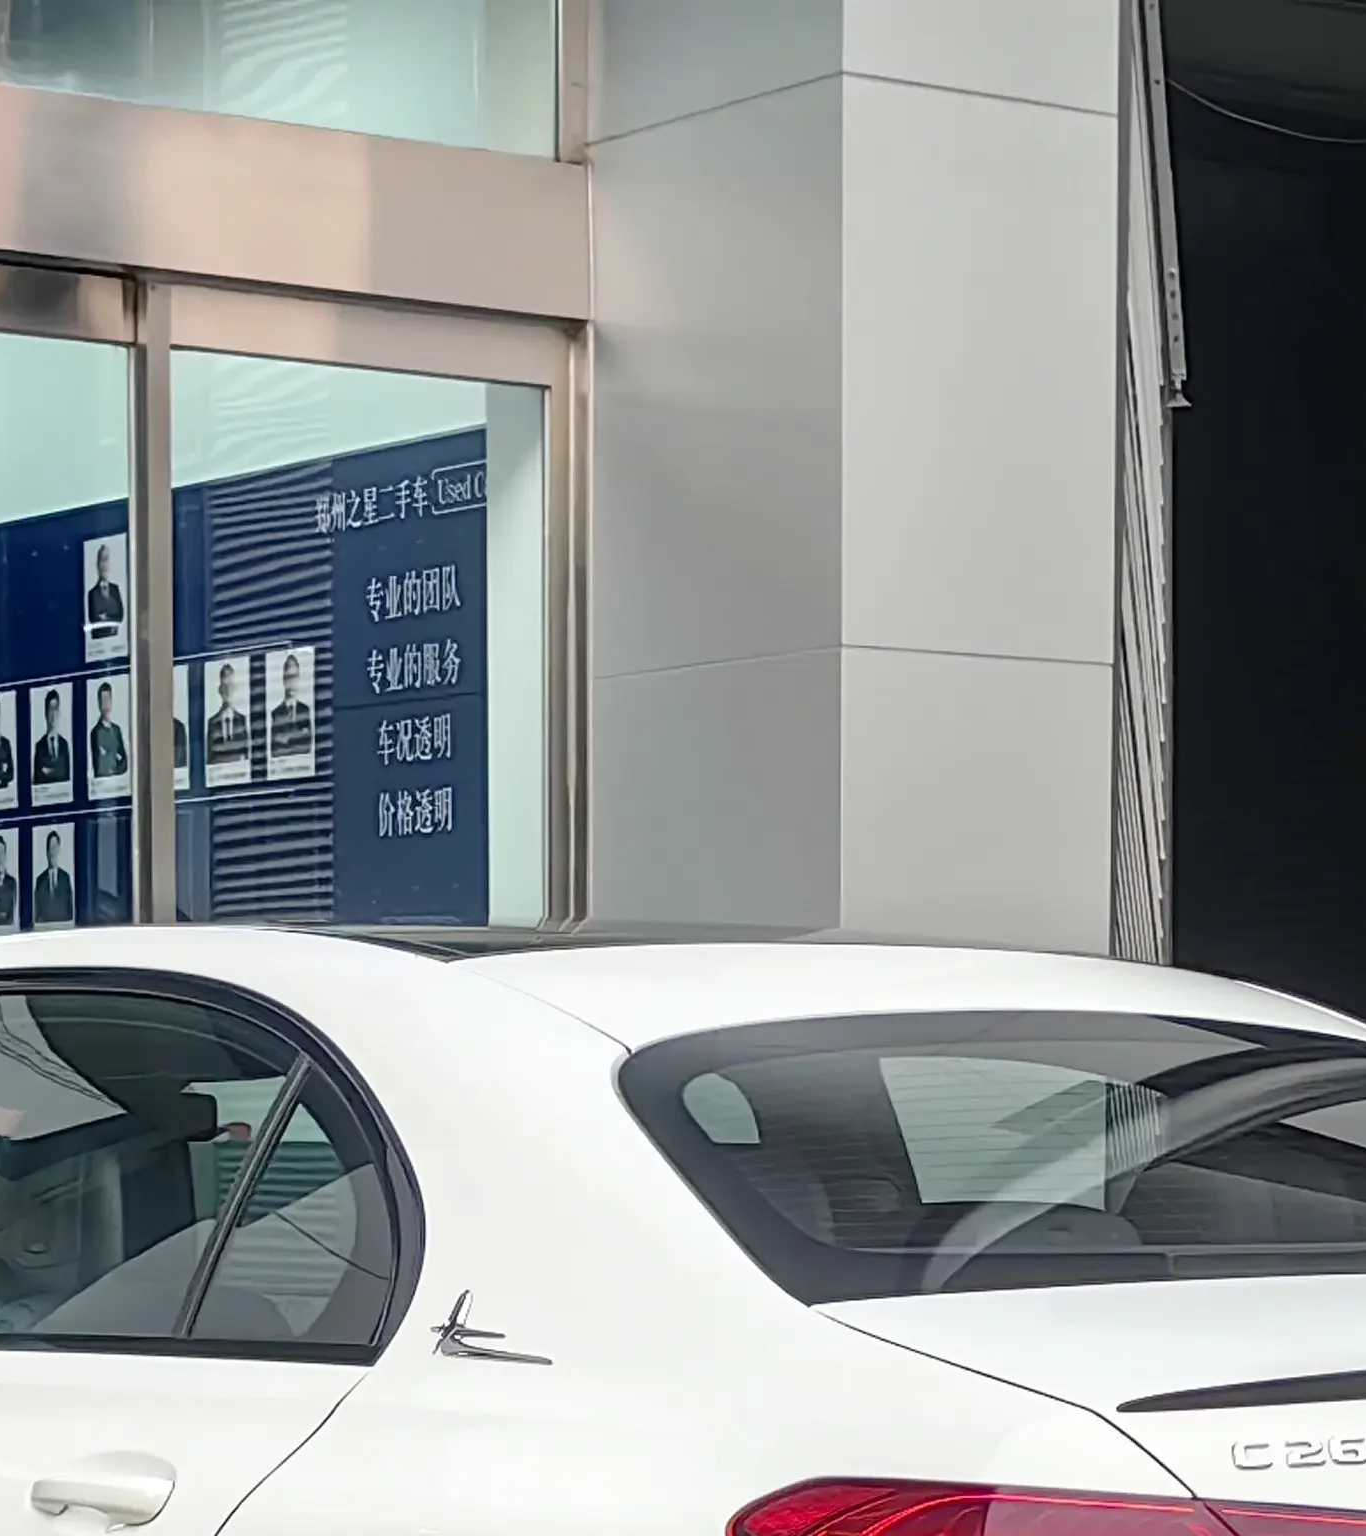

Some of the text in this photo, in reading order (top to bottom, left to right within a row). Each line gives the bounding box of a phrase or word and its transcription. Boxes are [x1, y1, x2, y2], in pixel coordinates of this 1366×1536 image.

[315, 476, 429, 534] 郑州之星二手车
[436, 473, 473, 505] Used
[366, 564, 461, 622] 专业的团队
[366, 638, 461, 694] 专业的服务
[377, 713, 451, 765] 车况透明
[379, 786, 453, 837] 价格透明
[1231, 1440, 1273, 1470] C
